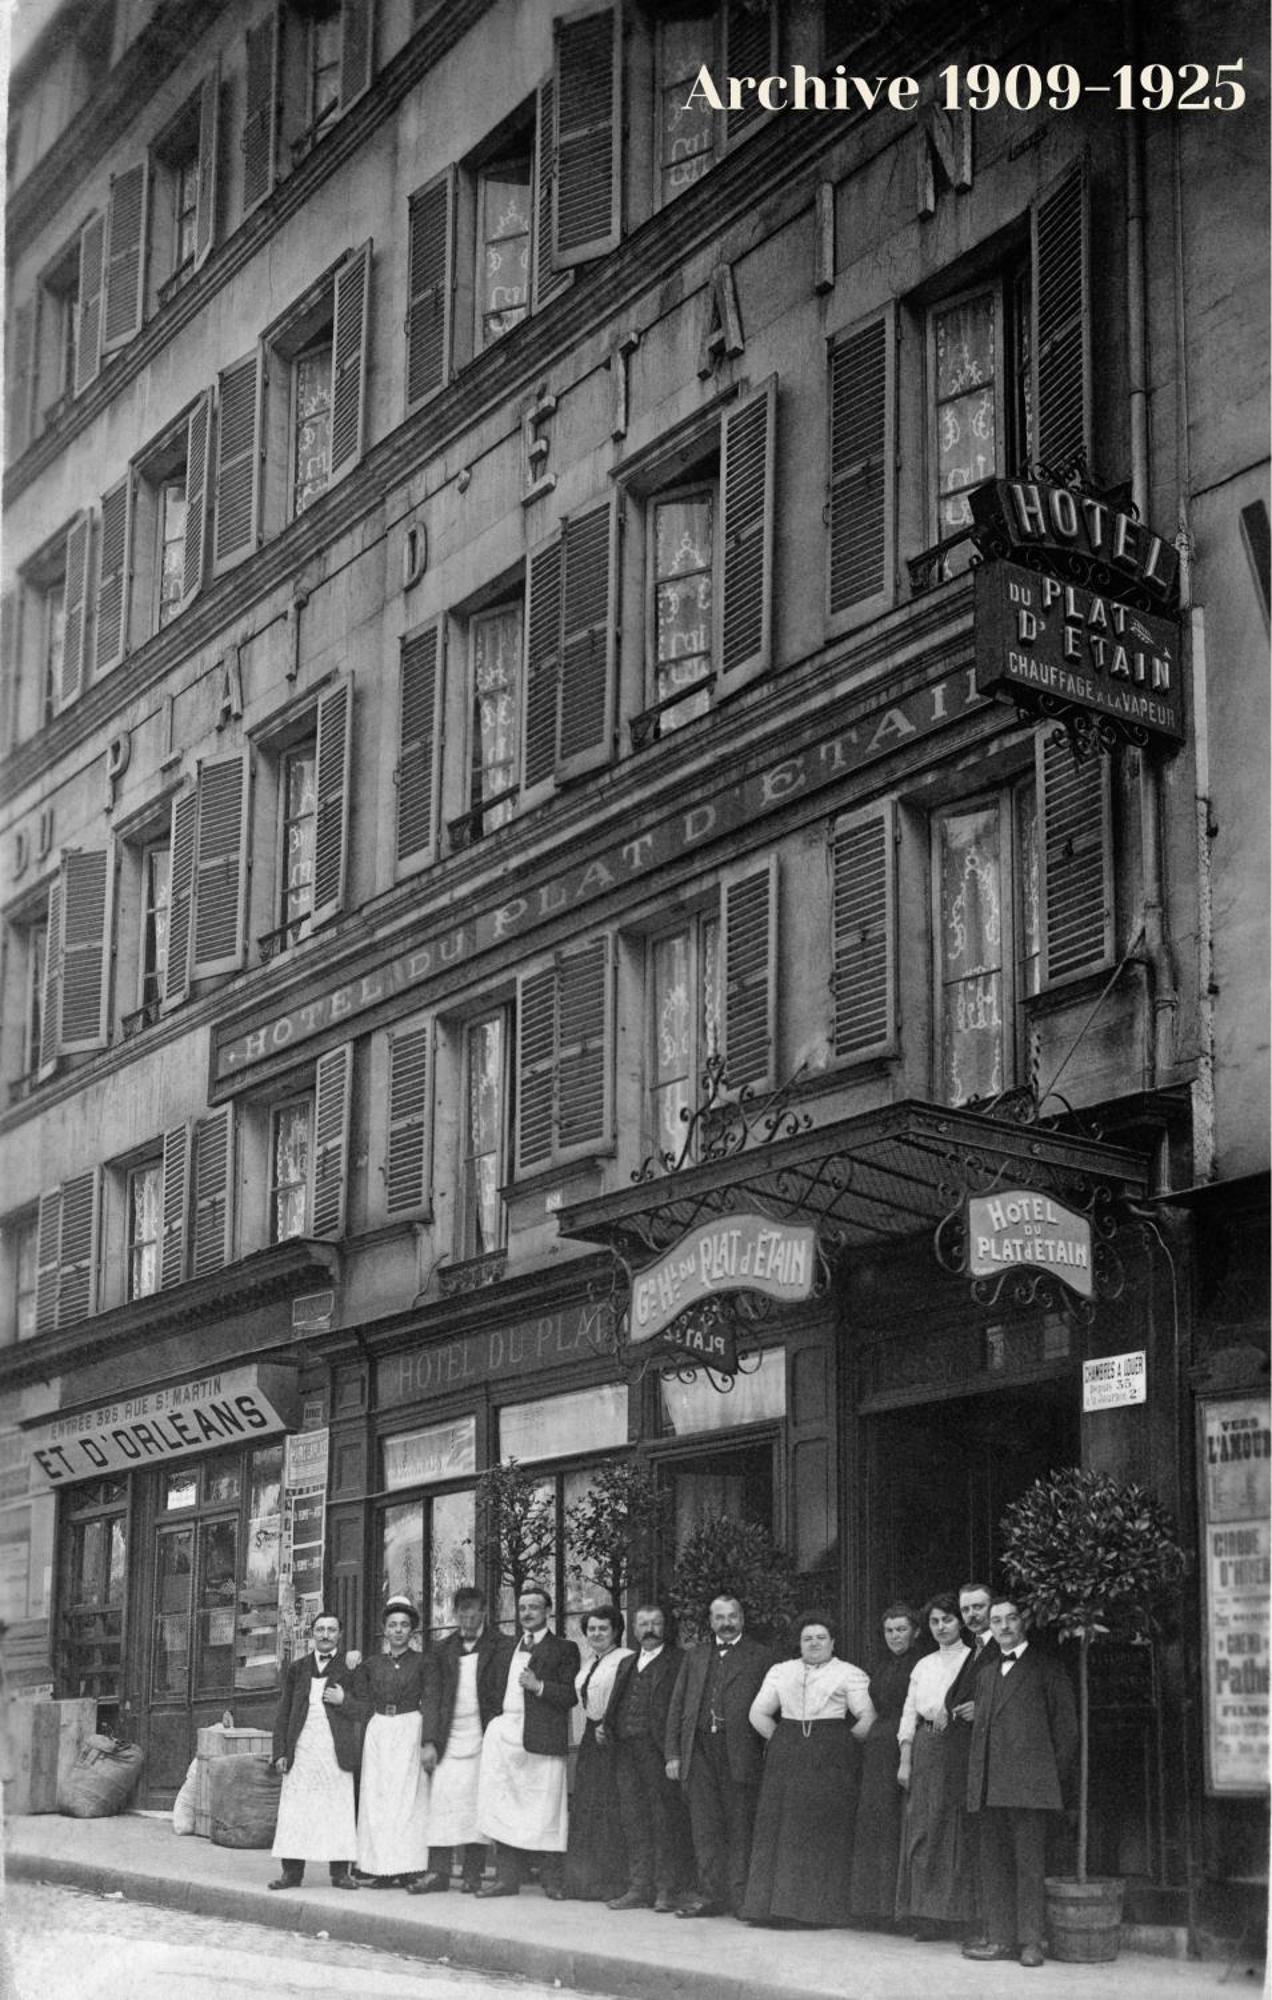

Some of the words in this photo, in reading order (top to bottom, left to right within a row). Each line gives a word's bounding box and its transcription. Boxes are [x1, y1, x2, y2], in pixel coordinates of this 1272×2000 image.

[1012, 483, 1168, 588] HOTEL
[1009, 582, 1032, 606] DU
[1042, 576, 1130, 636] PLAT
[106, 585, 310, 813] PLAT
[1008, 651, 1096, 701] CHAUFFAGE
[1120, 692, 1176, 729] VAPEUR
[245, 975, 383, 1060] HOTEL
[407, 931, 466, 979] DU
[492, 832, 654, 938] PLAT
[986, 1197, 1060, 1233] HOTEL
[1023, 1225, 1042, 1237] DU
[976, 1236, 1024, 1264] PLAT
[488, 1327, 525, 1371] DU
[124, 1397, 149, 1419] RUE
[172, 1375, 222, 1407] MARTIN
[1221, 1417, 1259, 1432] VERS
[33, 1444, 75, 1480] ET
